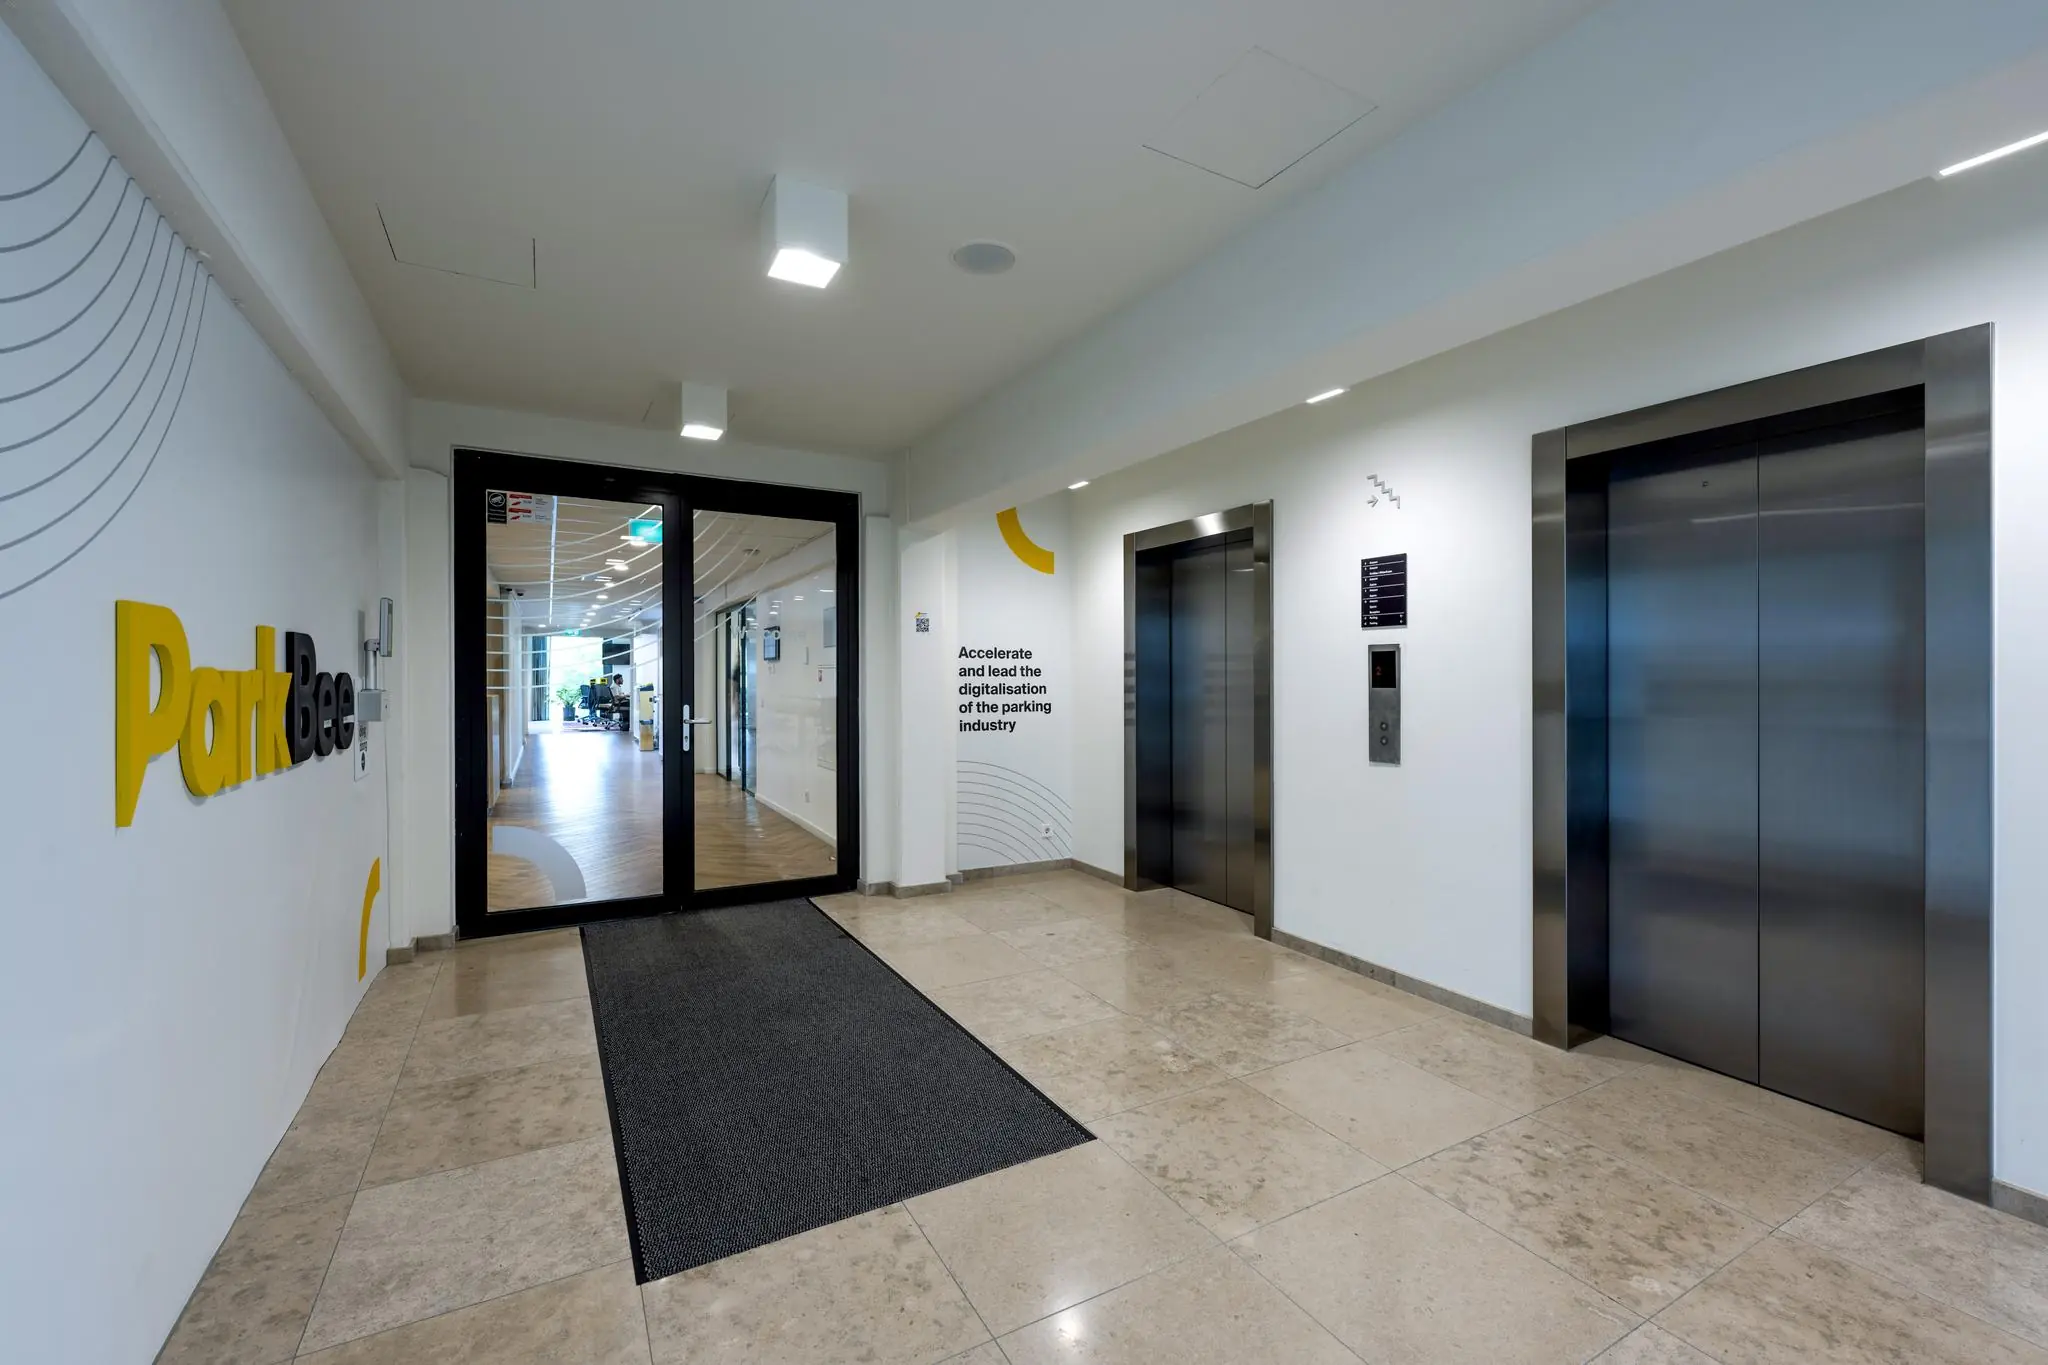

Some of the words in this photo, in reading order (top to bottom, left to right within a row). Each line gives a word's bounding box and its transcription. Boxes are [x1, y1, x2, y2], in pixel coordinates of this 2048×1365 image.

[958, 646, 1033, 659] Accelerate
[958, 665, 985, 677] and
[988, 665, 1017, 677] lead
[1020, 665, 1042, 677] the
[958, 682, 1047, 698] digitalisation
[115, 600, 354, 827] ParkBee
[959, 701, 974, 713] of
[976, 701, 999, 713] the
[1002, 700, 1052, 715] parking
[959, 719, 1016, 733] industry
